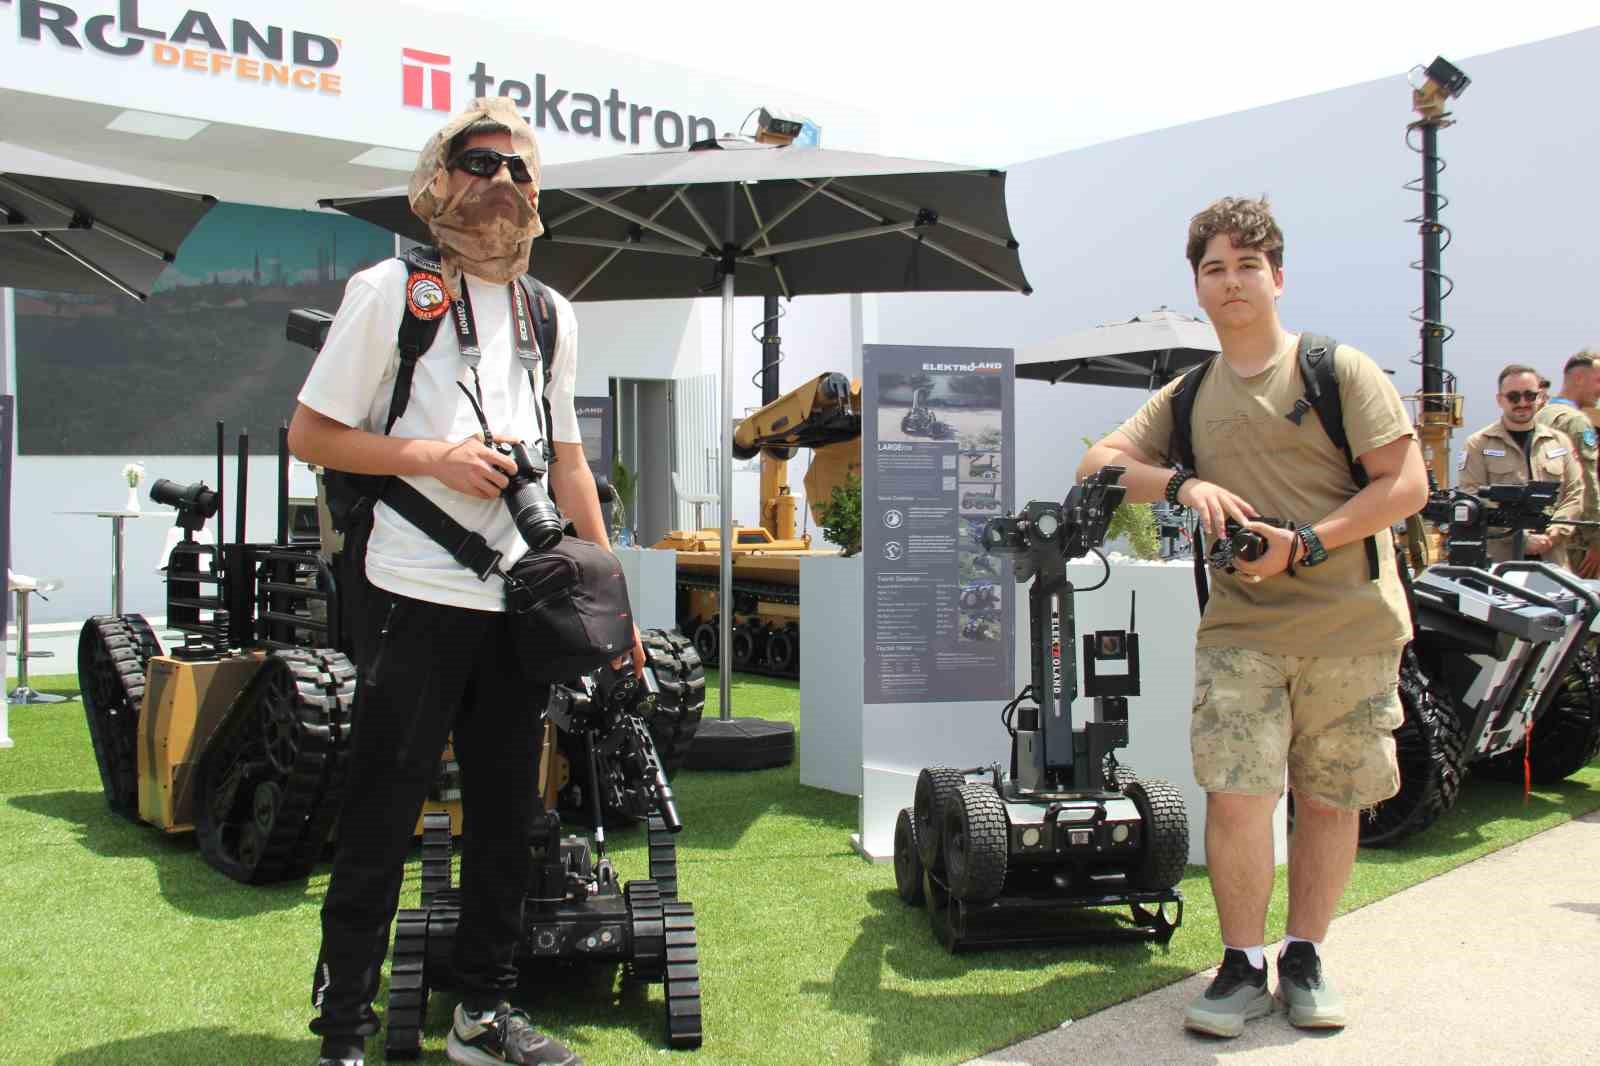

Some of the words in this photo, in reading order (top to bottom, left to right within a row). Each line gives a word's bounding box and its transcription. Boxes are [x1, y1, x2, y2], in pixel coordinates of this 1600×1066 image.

[0, 0, 339, 68] ROLAND
[153, 43, 341, 95] DEFENCE
[469, 61, 717, 148] tekatron
[456, 299, 470, 335] Canon
[922, 362, 1002, 372] ELEKTROLAND
